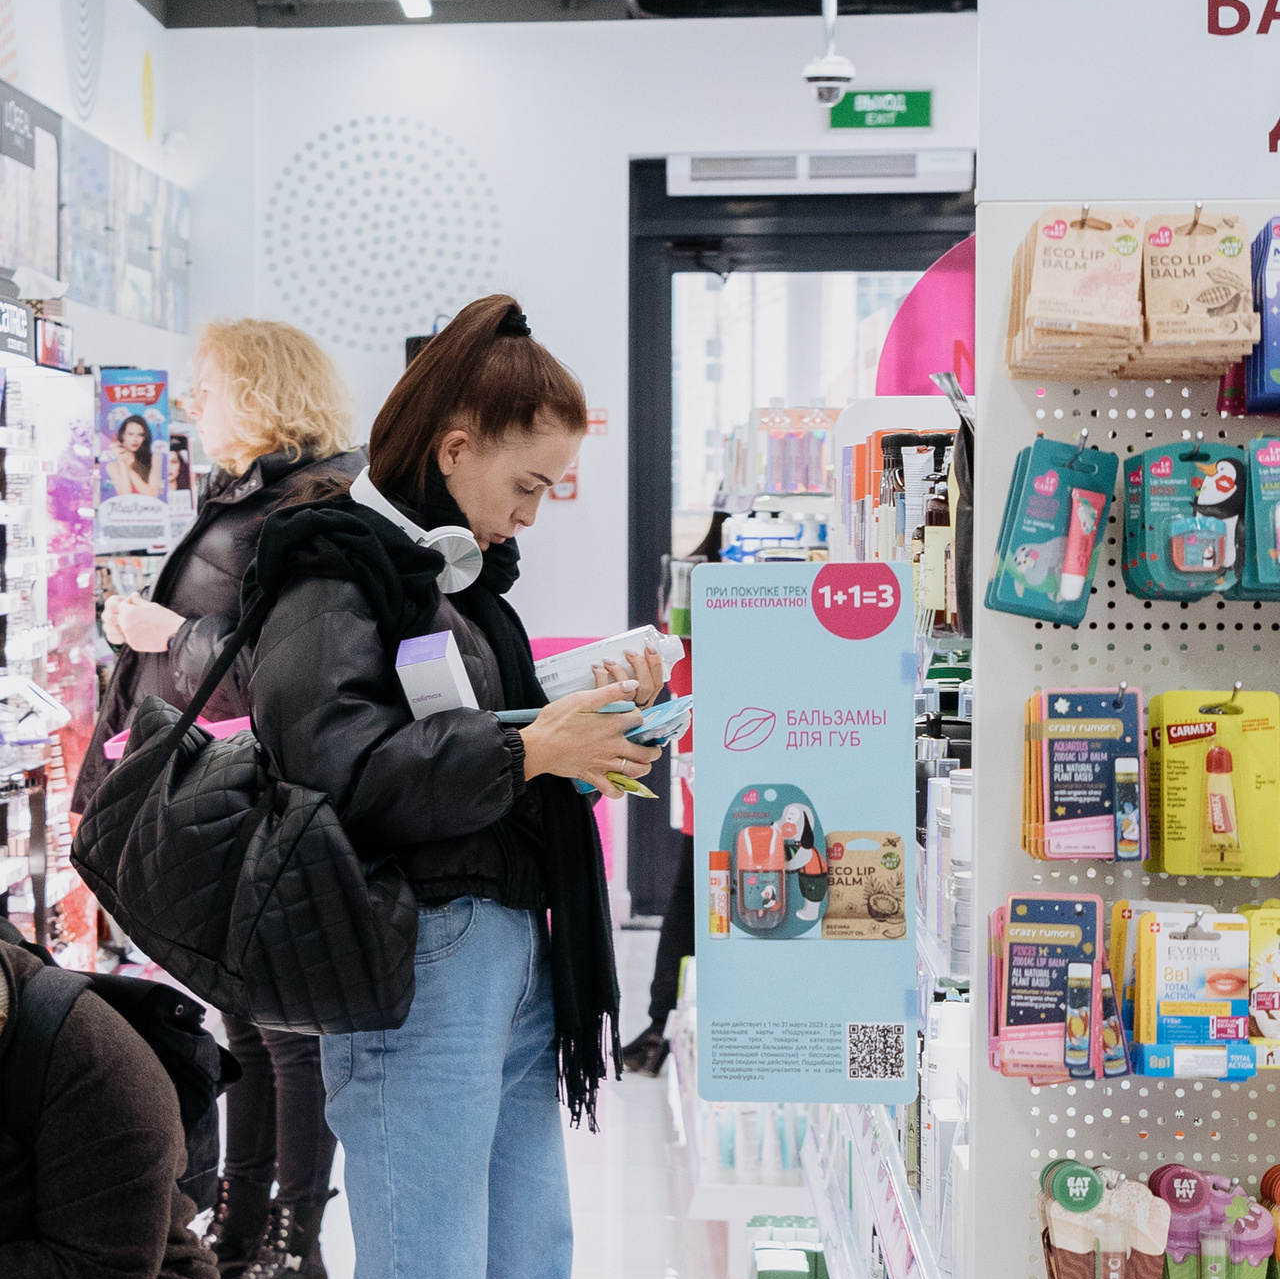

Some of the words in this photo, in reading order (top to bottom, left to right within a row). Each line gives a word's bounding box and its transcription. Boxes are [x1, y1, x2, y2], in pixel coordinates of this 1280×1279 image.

[1044, 247, 1075, 259] ECO
[1081, 248, 1105, 260] LIP
[1042, 259, 1087, 271] BALM
[1150, 256, 1182, 266] ECO
[1188, 255, 1212, 265] LIP
[1151, 269, 1195, 279] BALM
[113, 384, 157, 399] 1+1=3
[706, 587, 727, 597] ПРИ
[731, 586, 779, 597] ПОКУПКЕ
[783, 586, 808, 596] ТРЕХ
[818, 585, 894, 608] 1+1=3
[706, 598, 737, 609] ОДИН
[741, 598, 807, 608] БЕСПЛАТНО!
[787, 710, 887, 726] БАЛЬЗАМЫ
[1049, 724, 1076, 733] crazy
[1079, 723, 1116, 732] rumors
[1170, 722, 1214, 738] CARMEX
[786, 731, 822, 750] ДЛЯ
[829, 731, 861, 747] ГУБ
[1078, 752, 1088, 762] LIP
[1091, 751, 1107, 761] BALM
[1054, 763, 1063, 772] ALL
[1066, 763, 1092, 772] NATURAL
[1054, 772, 1071, 782] PLANT
[1074, 772, 1093, 781] BASED
[1211, 796, 1225, 831] CARMEX
[857, 866, 875, 876] LIP
[828, 877, 863, 886] BALM
[1009, 929, 1036, 938] crazy
[1039, 929, 1075, 938] rumors
[1168, 946, 1220, 955] EVELINE
[1036, 958, 1046, 967] LIP
[1012, 968, 1022, 976] ALL
[1024, 968, 1050, 977] NATURAL
[1012, 977, 1029, 987] PLANT
[1032, 978, 1050, 987] BASED
[1164, 992, 1196, 1000] ACTION
[1067, 1177, 1091, 1188] EAT
[1173, 1179, 1197, 1189] EAT
[1068, 1187, 1089, 1198] MY
[1175, 1189, 1195, 1199] MY
